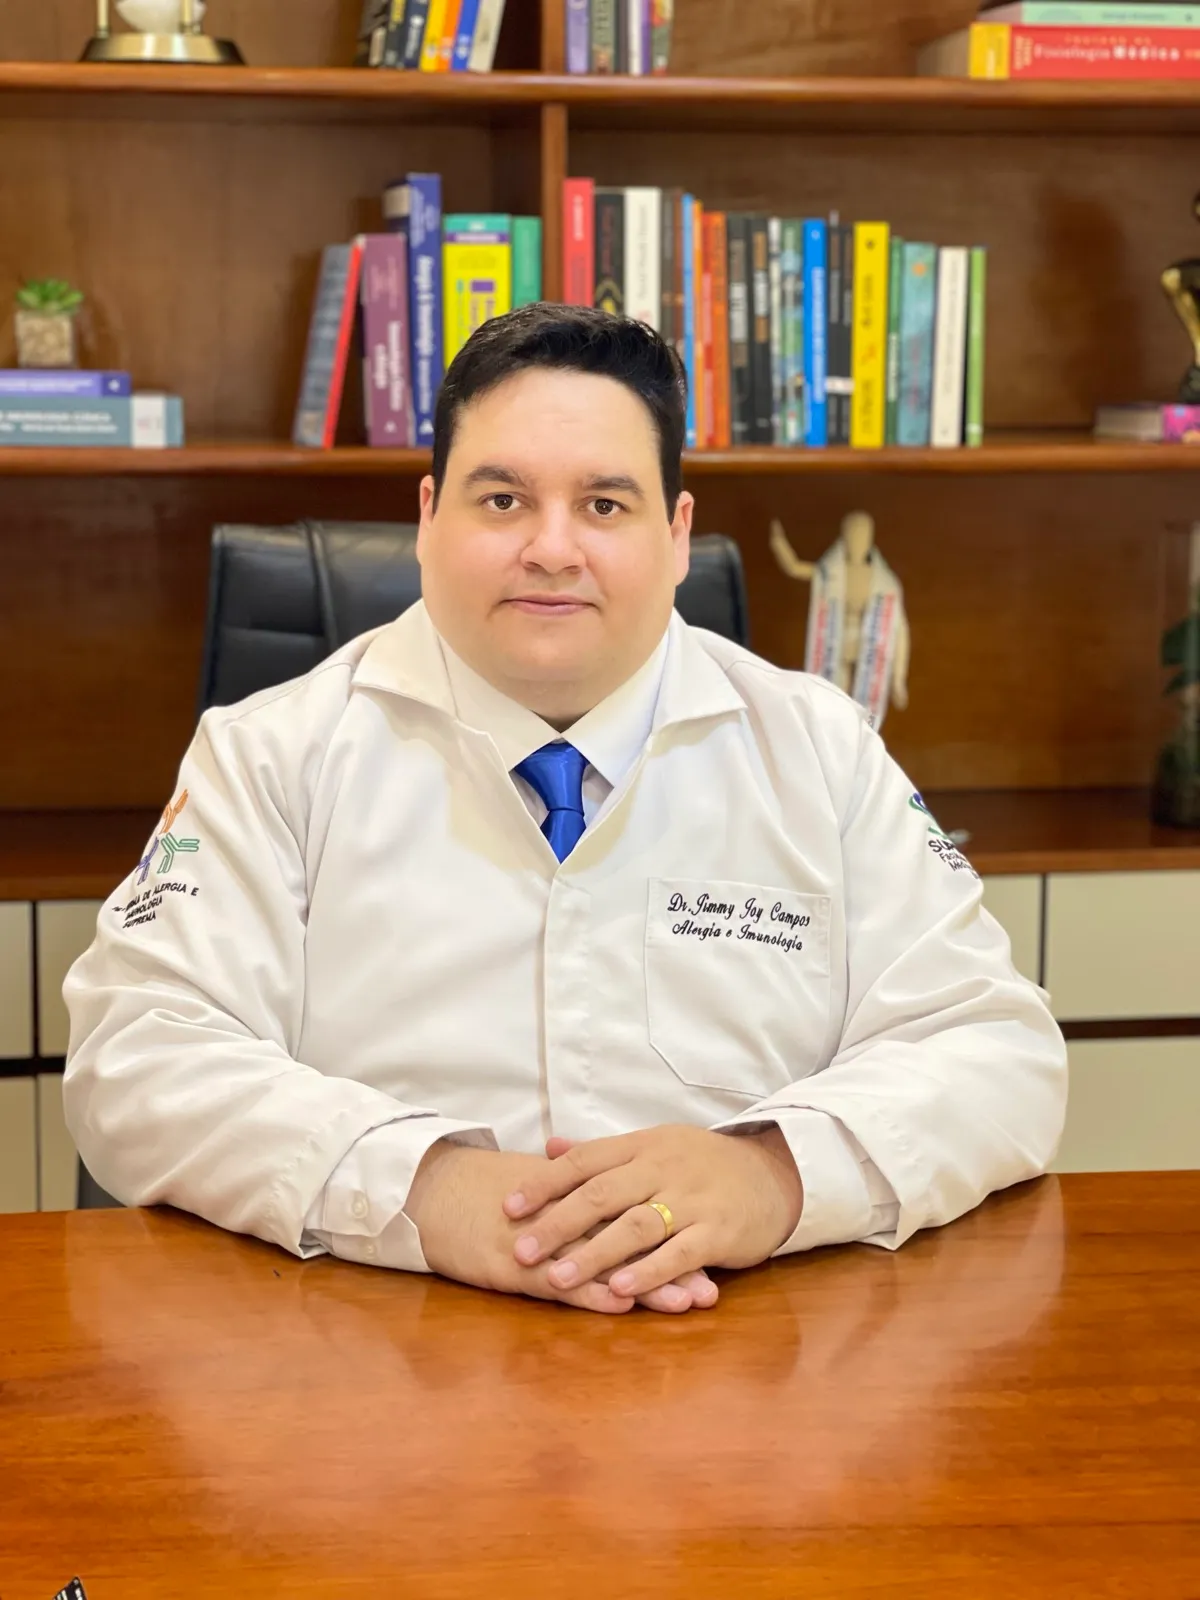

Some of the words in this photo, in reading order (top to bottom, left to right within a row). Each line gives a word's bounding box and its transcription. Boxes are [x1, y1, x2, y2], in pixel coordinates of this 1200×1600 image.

[152, 882, 187, 897] ALERGIA
[190, 886, 200, 897] E
[769, 901, 812, 931] Campos
[671, 919, 722, 941] Alergia
[725, 928, 733, 938] e
[736, 923, 804, 953] Imunologia
